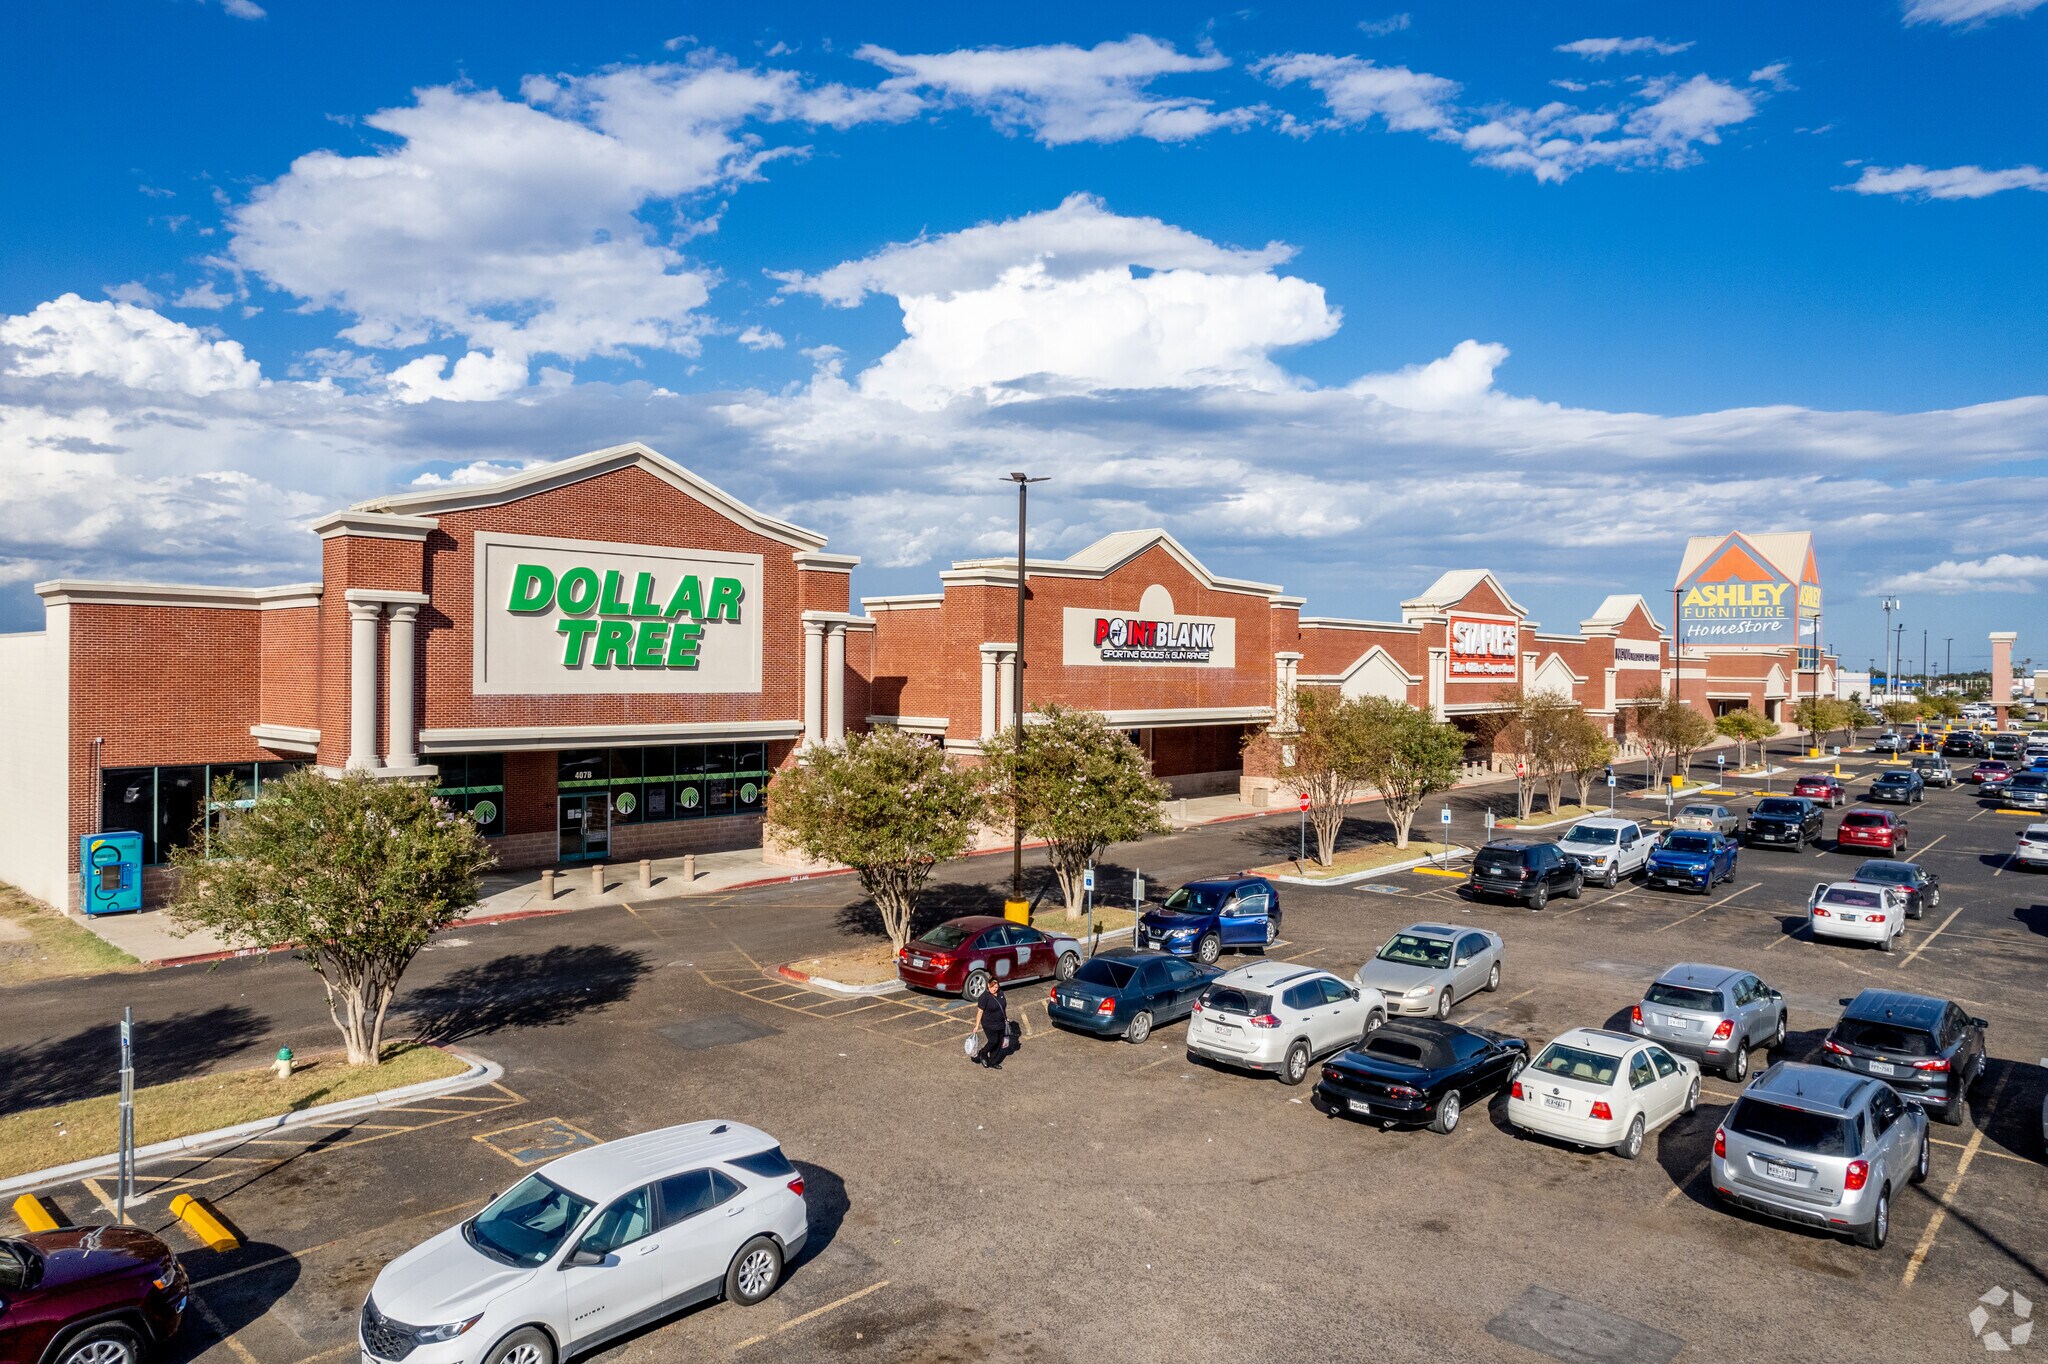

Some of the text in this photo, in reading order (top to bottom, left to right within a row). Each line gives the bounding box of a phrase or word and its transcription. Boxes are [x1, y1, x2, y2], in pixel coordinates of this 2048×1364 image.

[507, 563, 745, 622] DOLLAR
[1682, 583, 1791, 607] ASHLEY
[1684, 606, 1785, 618] FURNITURE
[556, 618, 703, 667] TREE
[1156, 622, 1215, 648] BLANK
[1453, 622, 1516, 656] STAPLES
[1103, 649, 1210, 661] SPORTING GOODS & GUN RANGE
